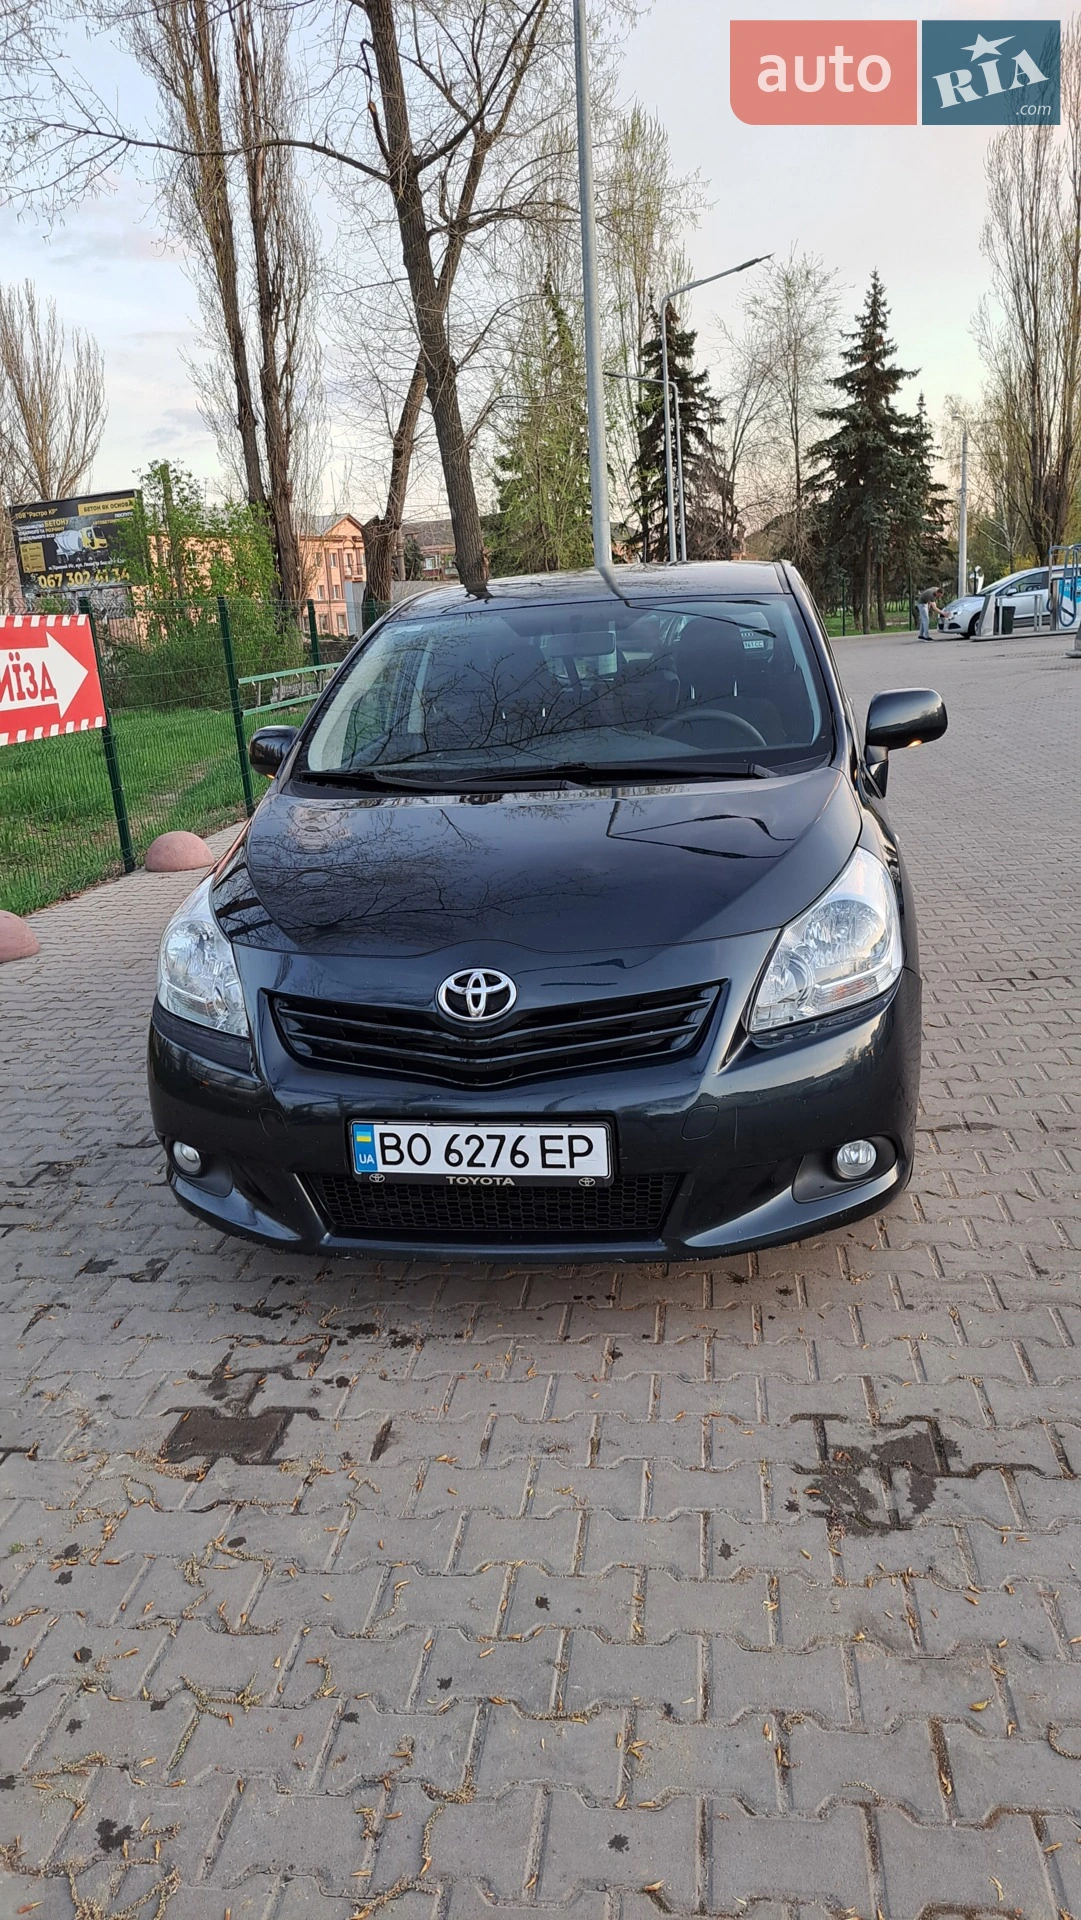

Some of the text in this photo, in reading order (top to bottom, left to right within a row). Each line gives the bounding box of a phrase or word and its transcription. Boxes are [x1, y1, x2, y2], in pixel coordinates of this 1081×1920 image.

[83, 504, 101, 512] БЕТОН
[44, 519, 69, 527] БЕТОНУ
[38, 573, 63, 589] 067
[66, 570, 91, 587] 302
[379, 1131, 594, 1169] BO 6276 EP
[358, 1153, 375, 1165] UA
[446, 1175, 516, 1187] TOYOTA
